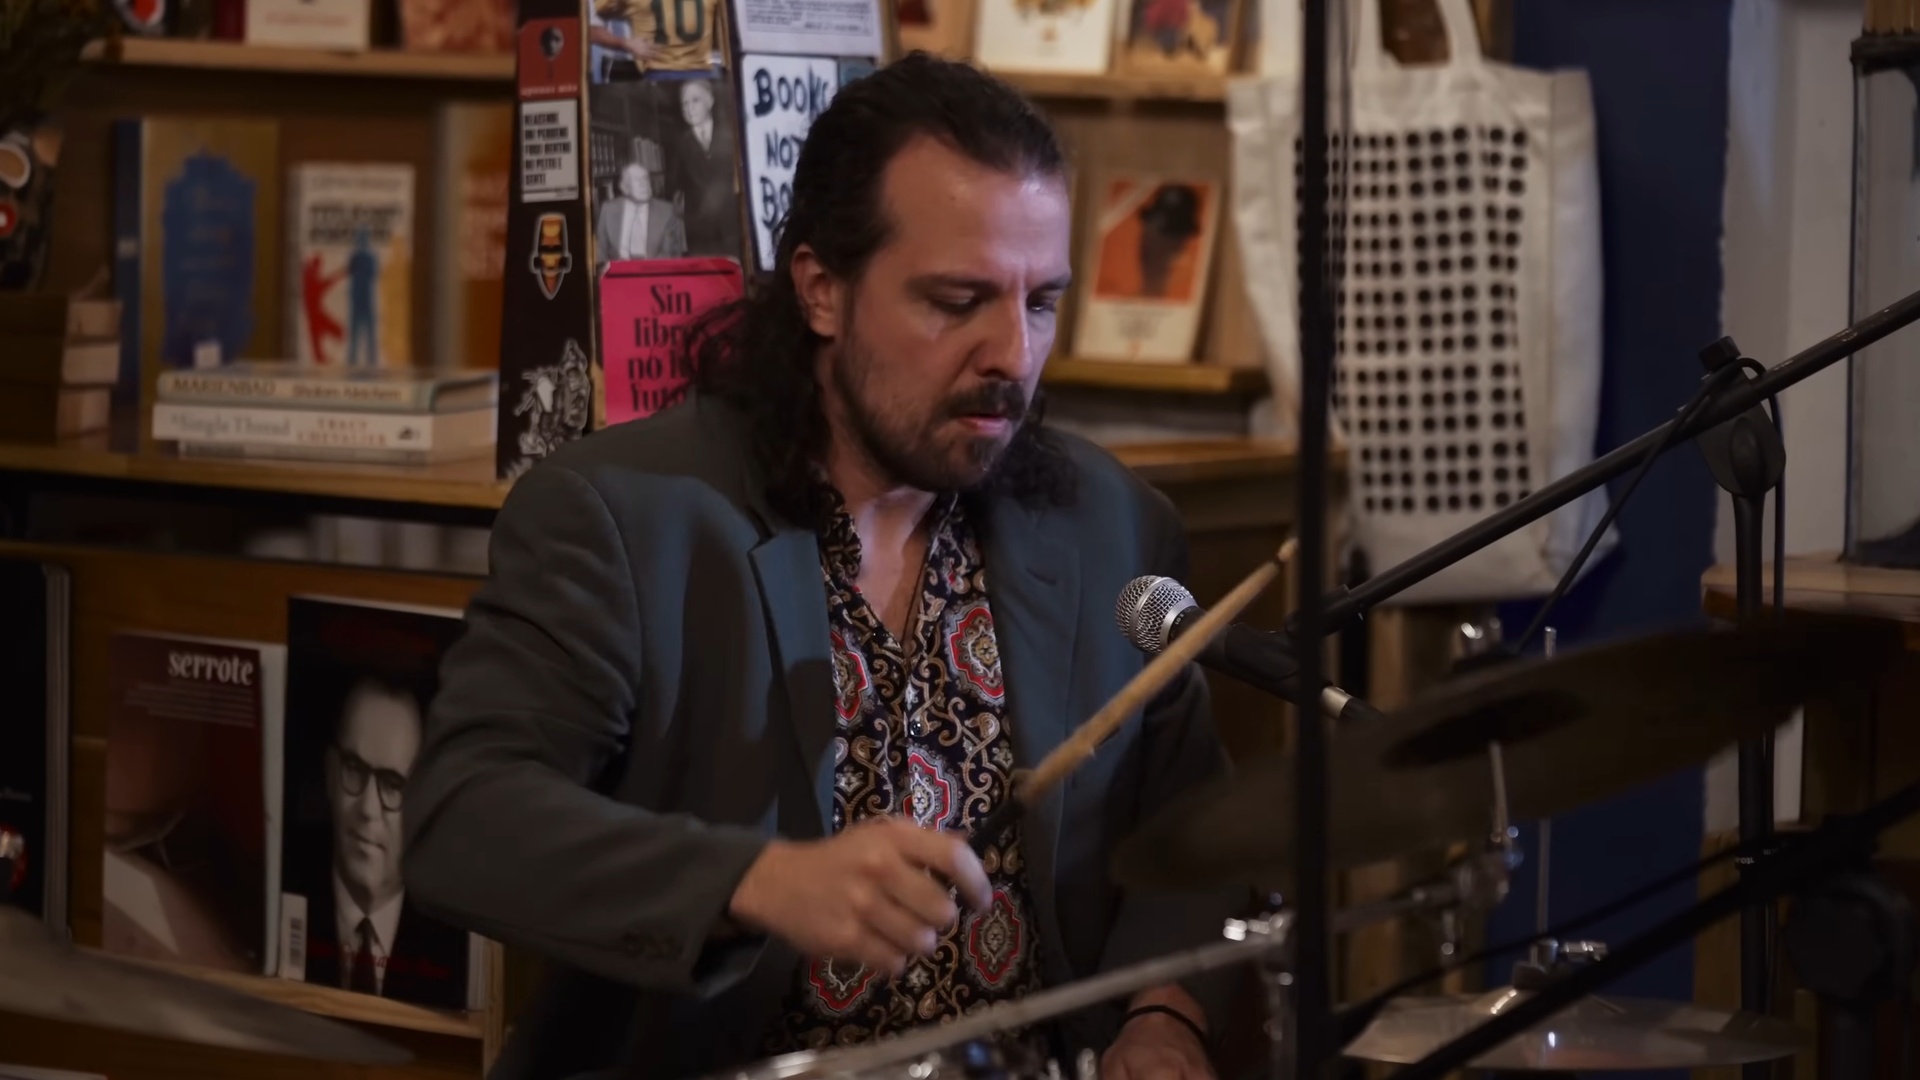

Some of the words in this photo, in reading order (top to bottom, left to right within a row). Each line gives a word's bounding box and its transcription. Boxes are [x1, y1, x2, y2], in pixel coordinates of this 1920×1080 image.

[651, 0, 704, 44] 10
[650, 284, 692, 315] Sin
[634, 317, 684, 348] libr
[628, 355, 663, 380] no
[167, 650, 254, 686] serrote
